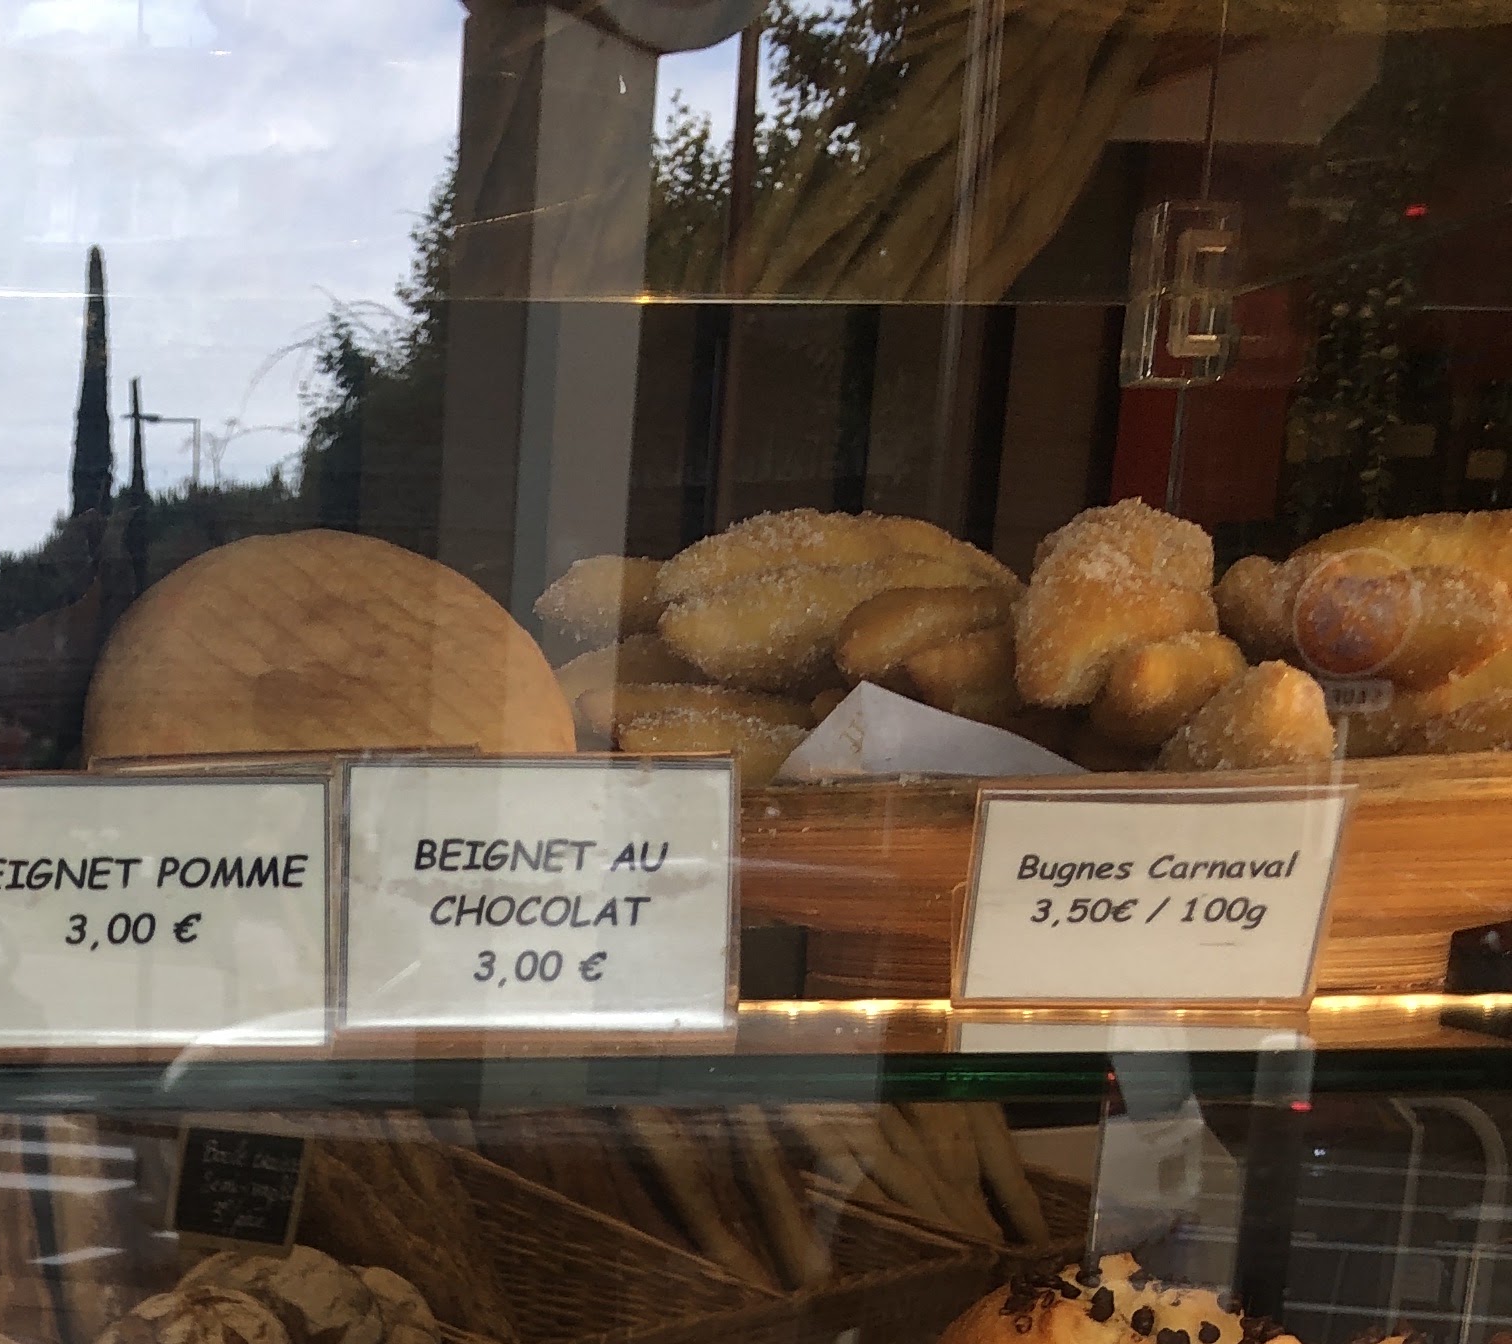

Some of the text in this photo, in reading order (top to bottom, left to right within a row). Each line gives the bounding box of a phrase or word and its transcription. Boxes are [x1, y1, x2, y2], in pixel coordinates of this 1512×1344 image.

[157, 854, 309, 889] POMME
[415, 839, 670, 872] BEIGNET AU
[1017, 850, 1300, 888] Bugnes Carnaval
[429, 895, 652, 928] CHOCOLAT
[1030, 896, 1268, 929] 3,50€ / 100g
[65, 912, 201, 951] 3,00 €
[473, 950, 607, 988] 3,00 €
